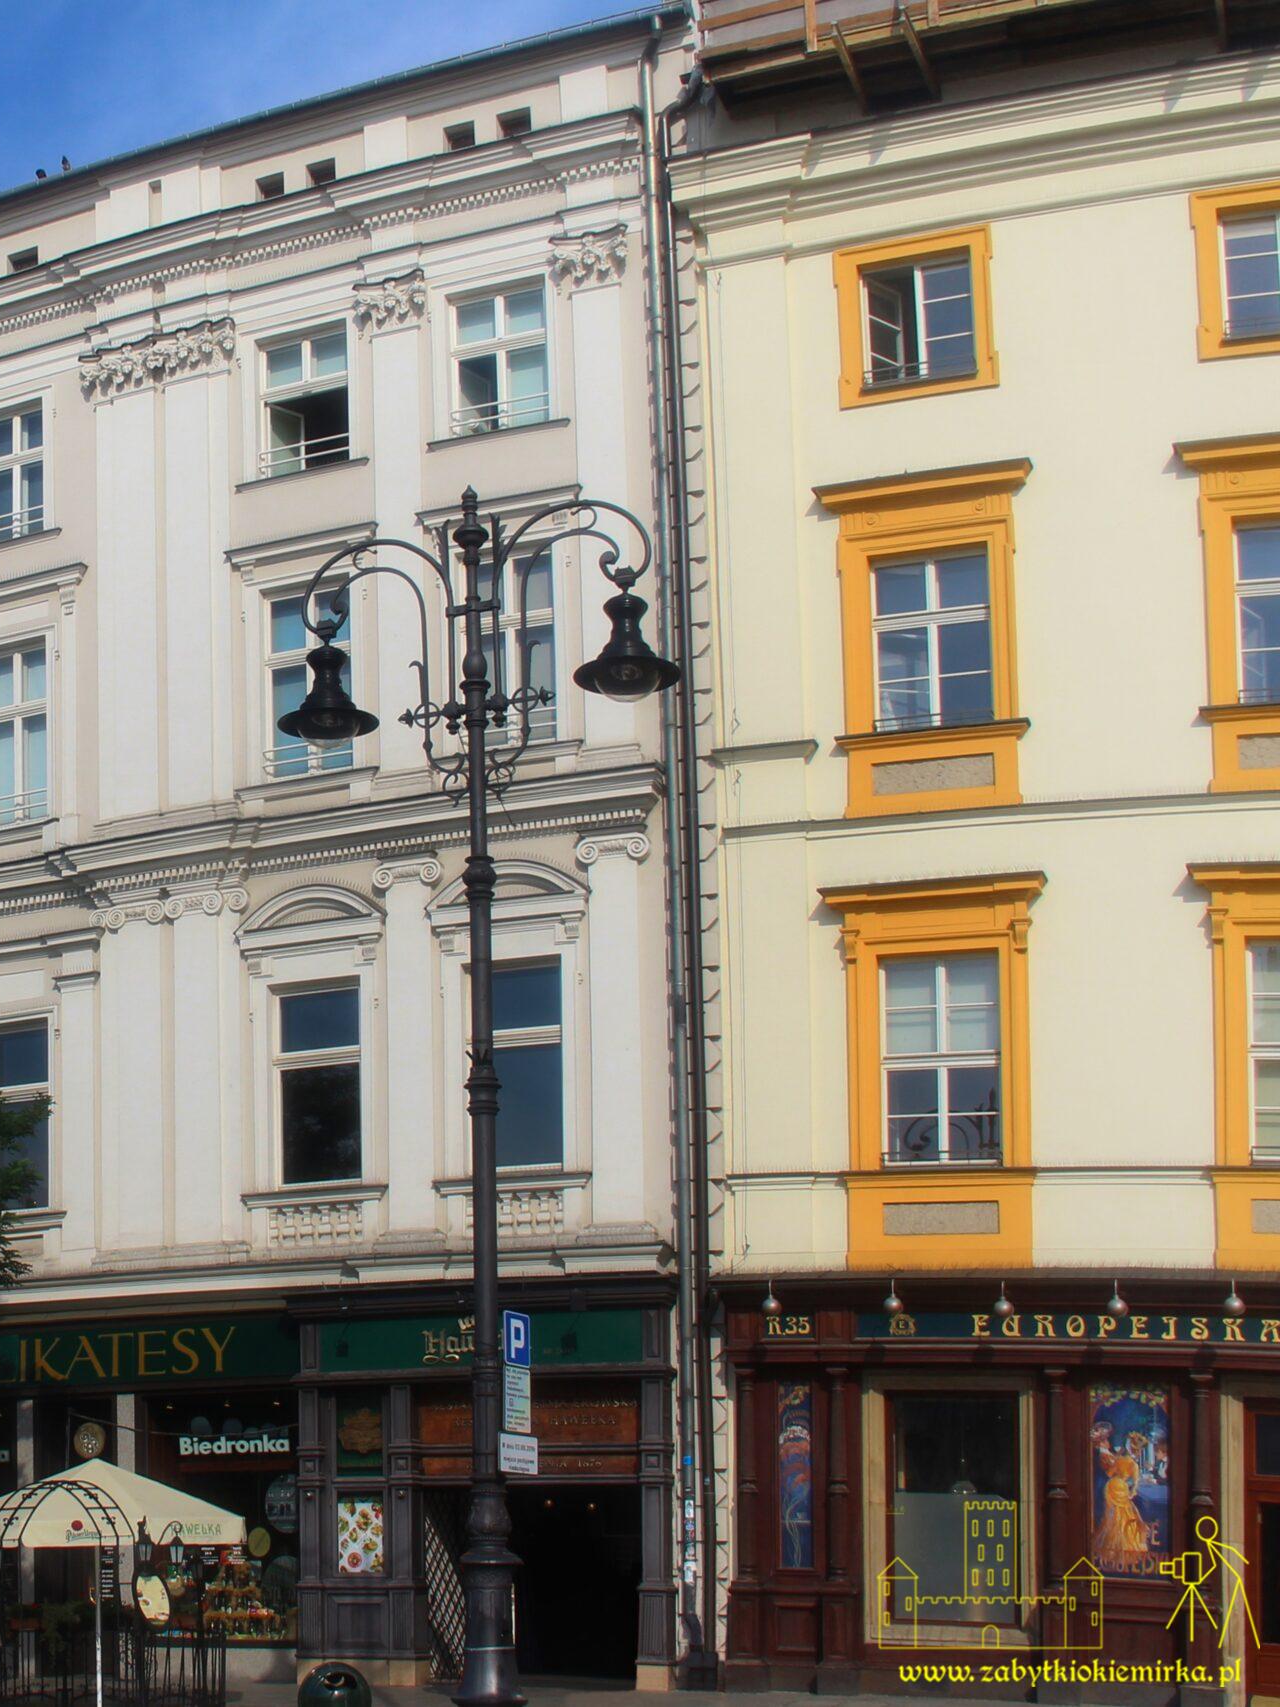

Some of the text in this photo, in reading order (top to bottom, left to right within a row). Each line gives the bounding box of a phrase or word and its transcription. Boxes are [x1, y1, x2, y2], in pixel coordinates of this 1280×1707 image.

[510, 1318, 525, 1359] P
[766, 1316, 811, 1336] R.35
[971, 1314, 1280, 1343] EUROPEJSKA
[179, 1434, 290, 1456] Biedronka
